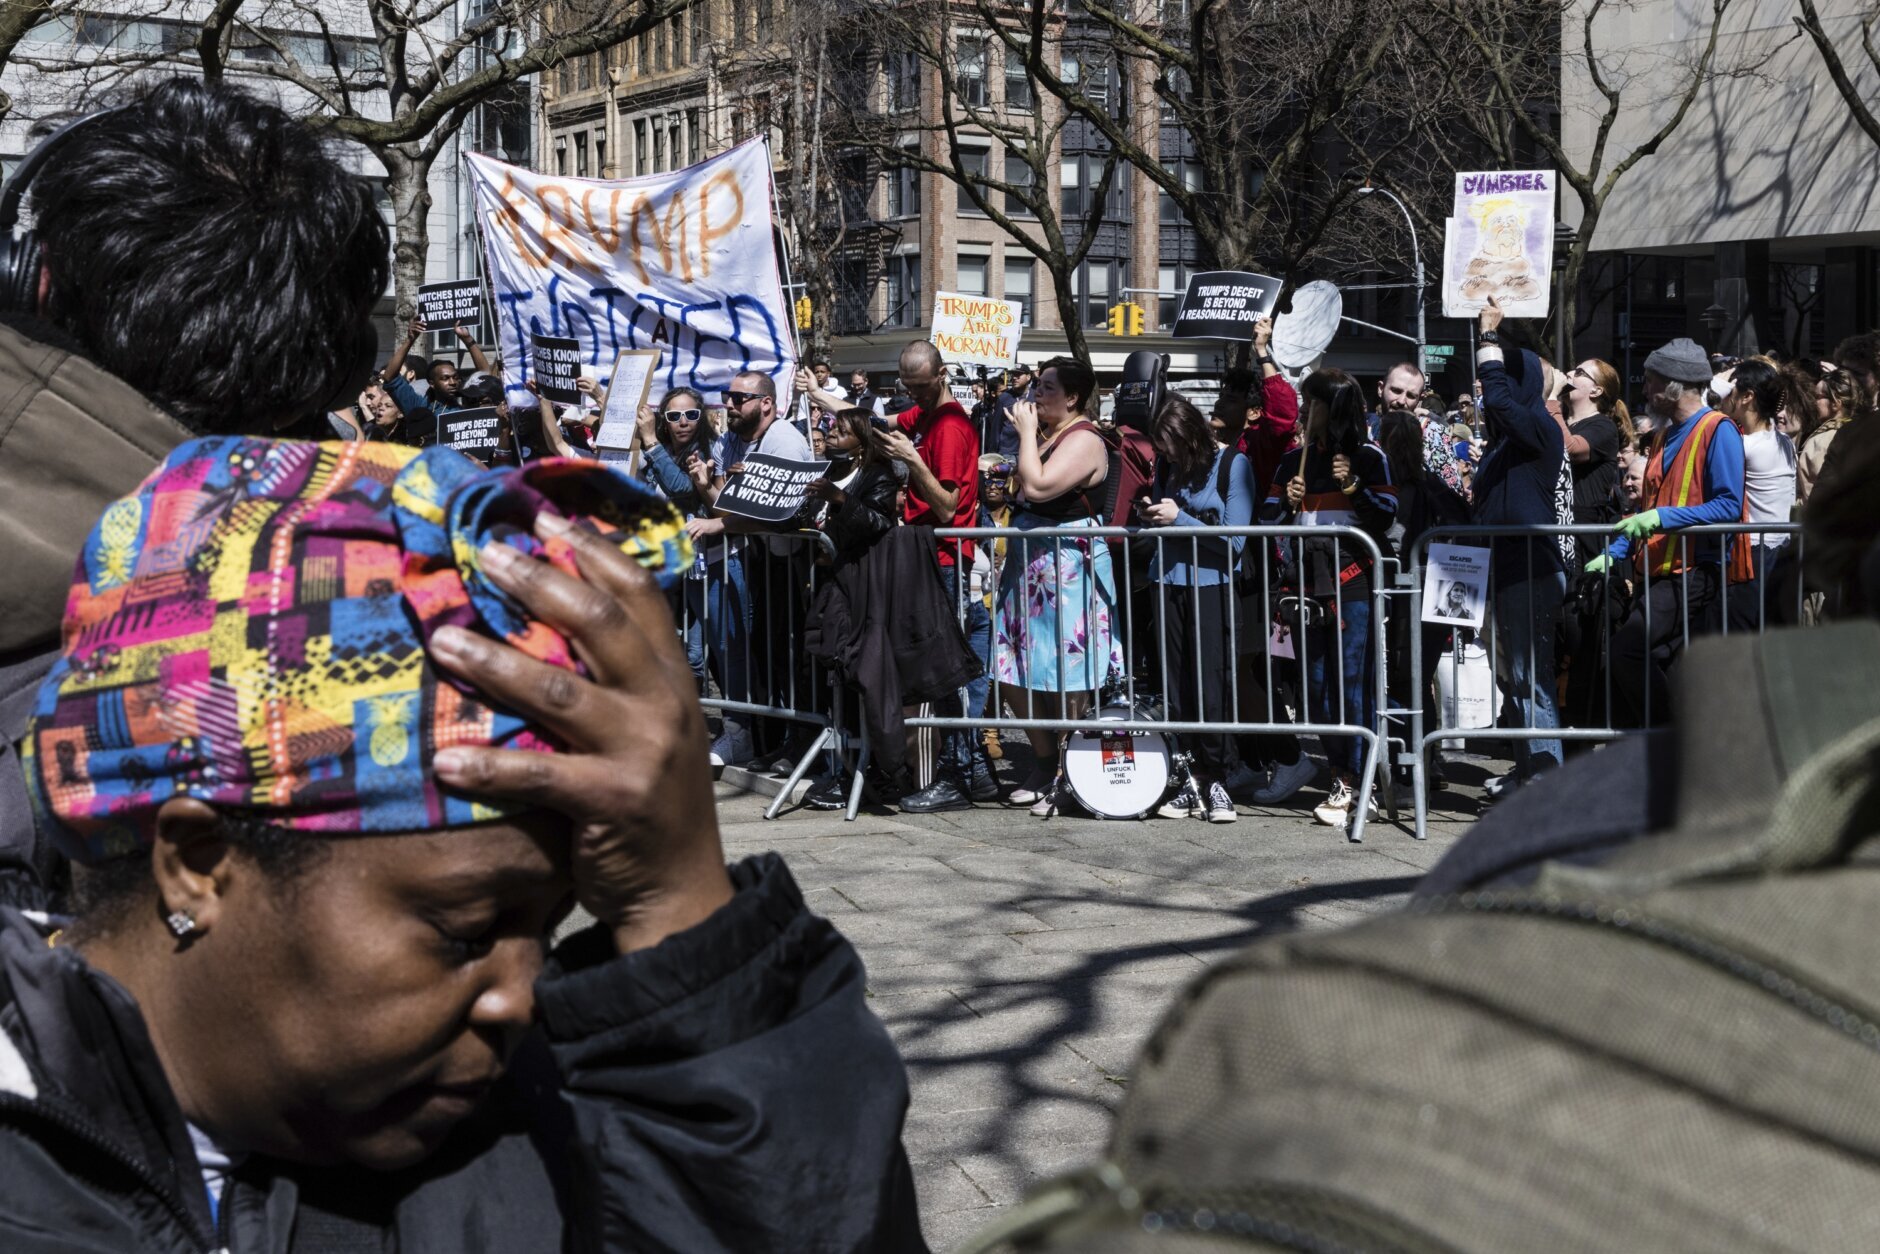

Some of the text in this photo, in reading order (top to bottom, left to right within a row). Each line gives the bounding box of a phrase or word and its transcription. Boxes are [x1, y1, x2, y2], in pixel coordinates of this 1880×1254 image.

[495, 168, 745, 287] TRUMP
[418, 287, 480, 303] WITCHES KNOW
[1197, 285, 1264, 299] TRUMP'S DECEIT
[425, 298, 473, 312] THIS IS NOT
[1203, 297, 1246, 309] IS BEYOND
[420, 307, 479, 322] A WITCH HUNT
[1179, 309, 1263, 322] A REASONABLE DOUB
[962, 317, 1001, 335] A BIG
[553, 349, 580, 363] KNOW
[545, 361, 553, 374] IS
[554, 363, 573, 376] NOT
[554, 377, 577, 391] HUNT
[953, 391, 967, 399] EACH
[446, 418, 499, 433] TRUMP'S DECEIT
[454, 428, 488, 441] IS BEYOND
[443, 438, 482, 450] EASONABLE
[743, 461, 824, 483] WITCHES KNOW
[741, 474, 807, 496] THIS IS NOT
[724, 484, 804, 508] A WITCH HUNT
